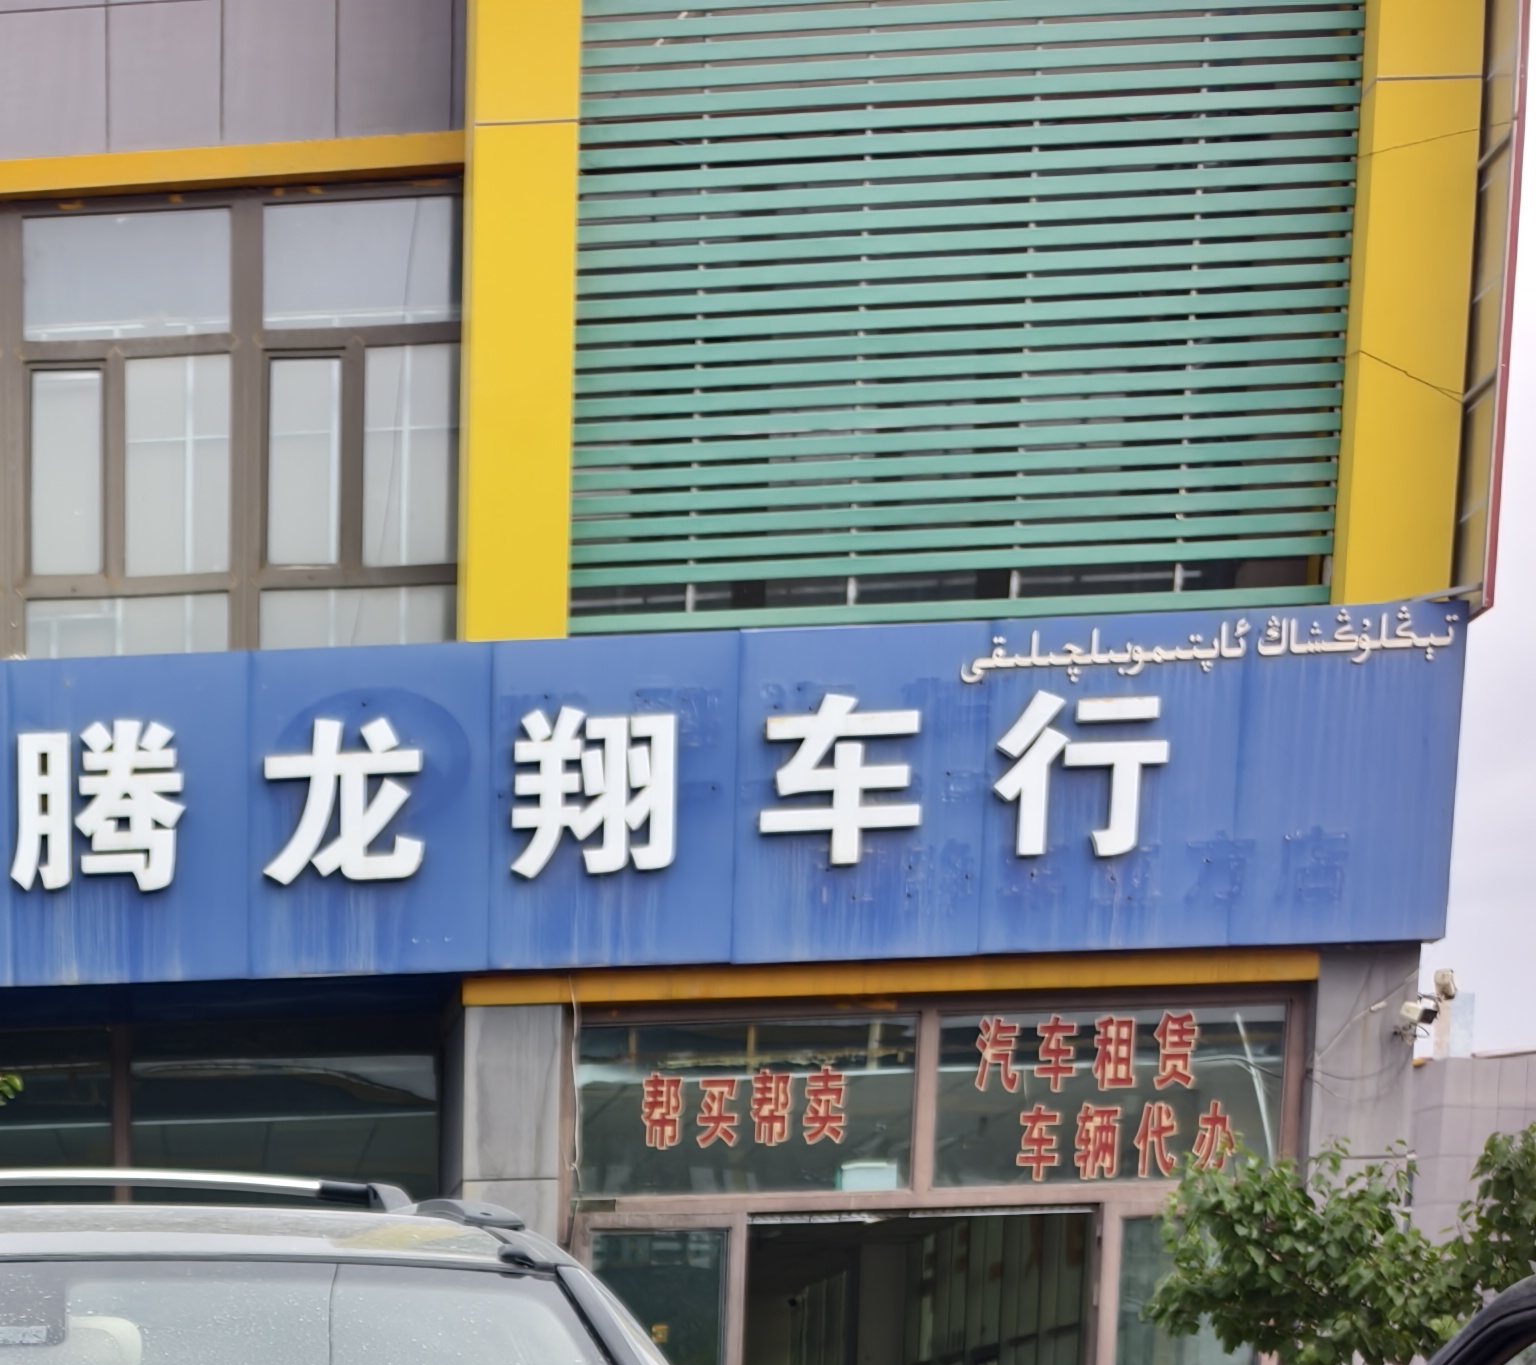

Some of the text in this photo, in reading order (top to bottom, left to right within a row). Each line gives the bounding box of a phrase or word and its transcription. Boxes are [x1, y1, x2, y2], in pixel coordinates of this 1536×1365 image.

[10, 690, 1170, 893] 腾龙翔车行
[973, 1009, 1199, 1093] 汽车租赁
[640, 1064, 848, 1151] 帮买帮卖
[1015, 1098, 1237, 1183] 车辆代办
